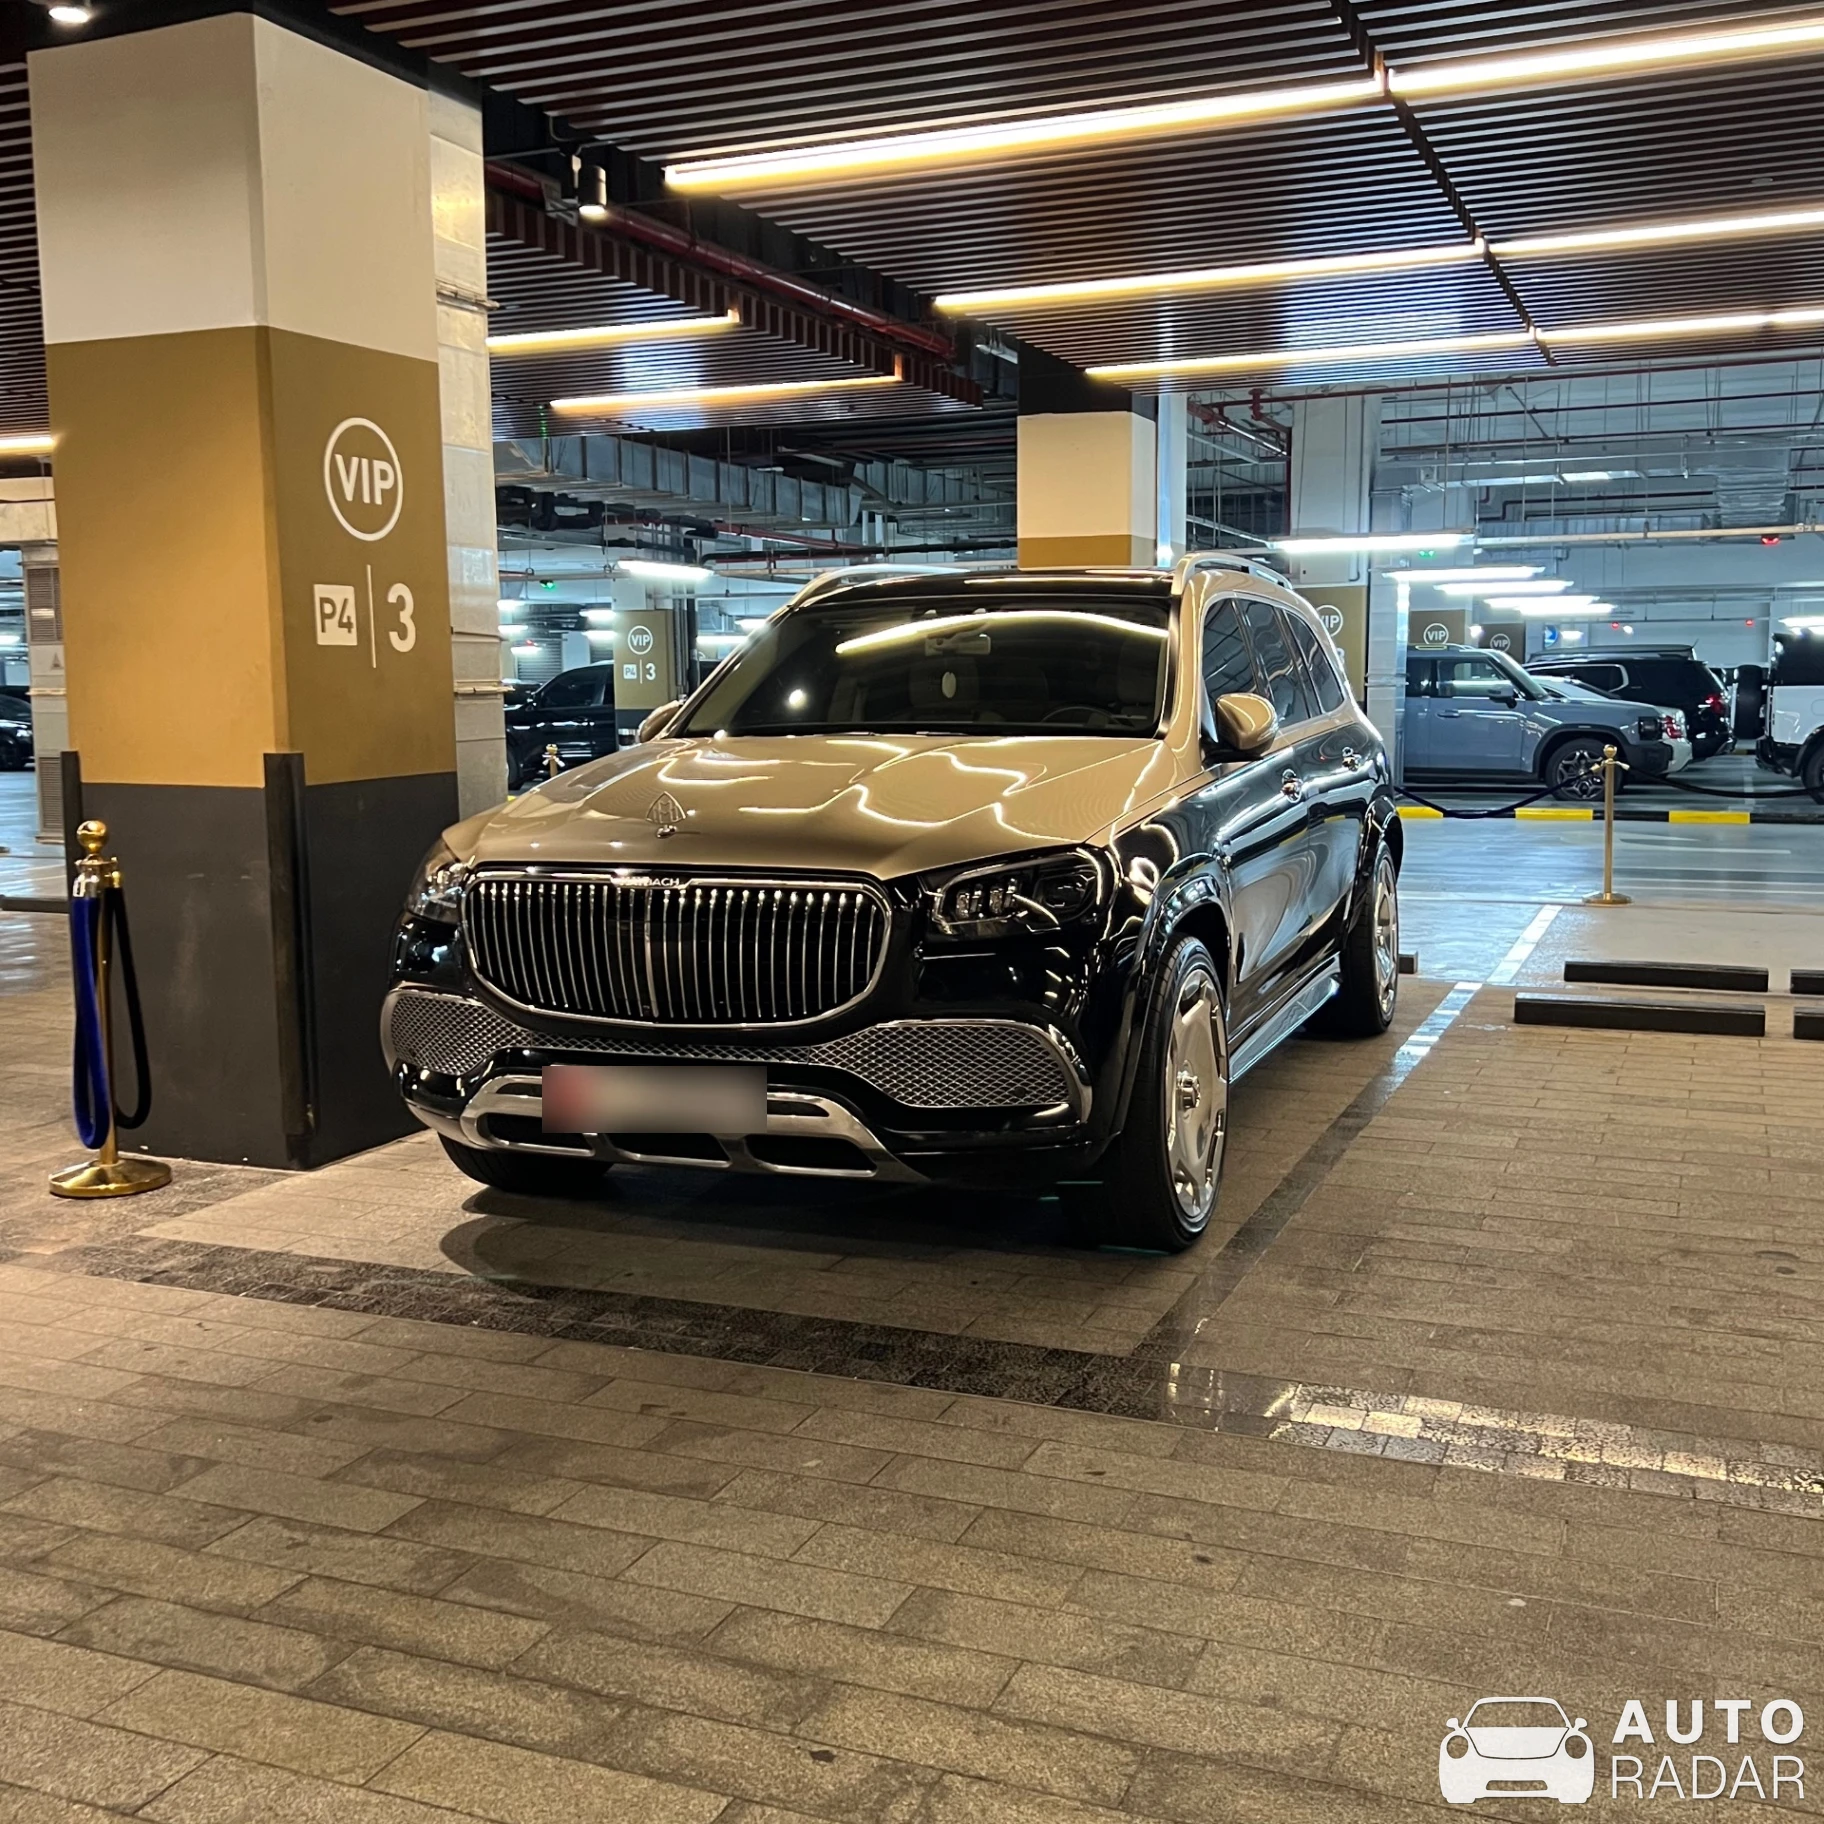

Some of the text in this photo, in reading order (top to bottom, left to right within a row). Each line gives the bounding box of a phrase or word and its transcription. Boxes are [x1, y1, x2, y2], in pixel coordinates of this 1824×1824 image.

[335, 453, 395, 505] VIP
[319, 583, 416, 652] P4 3
[1320, 614, 1340, 628] IP
[631, 634, 651, 646] VIP
[1427, 630, 1447, 641] VIP
[1492, 638, 1508, 648] VIP
[624, 662, 656, 680] P4 3
